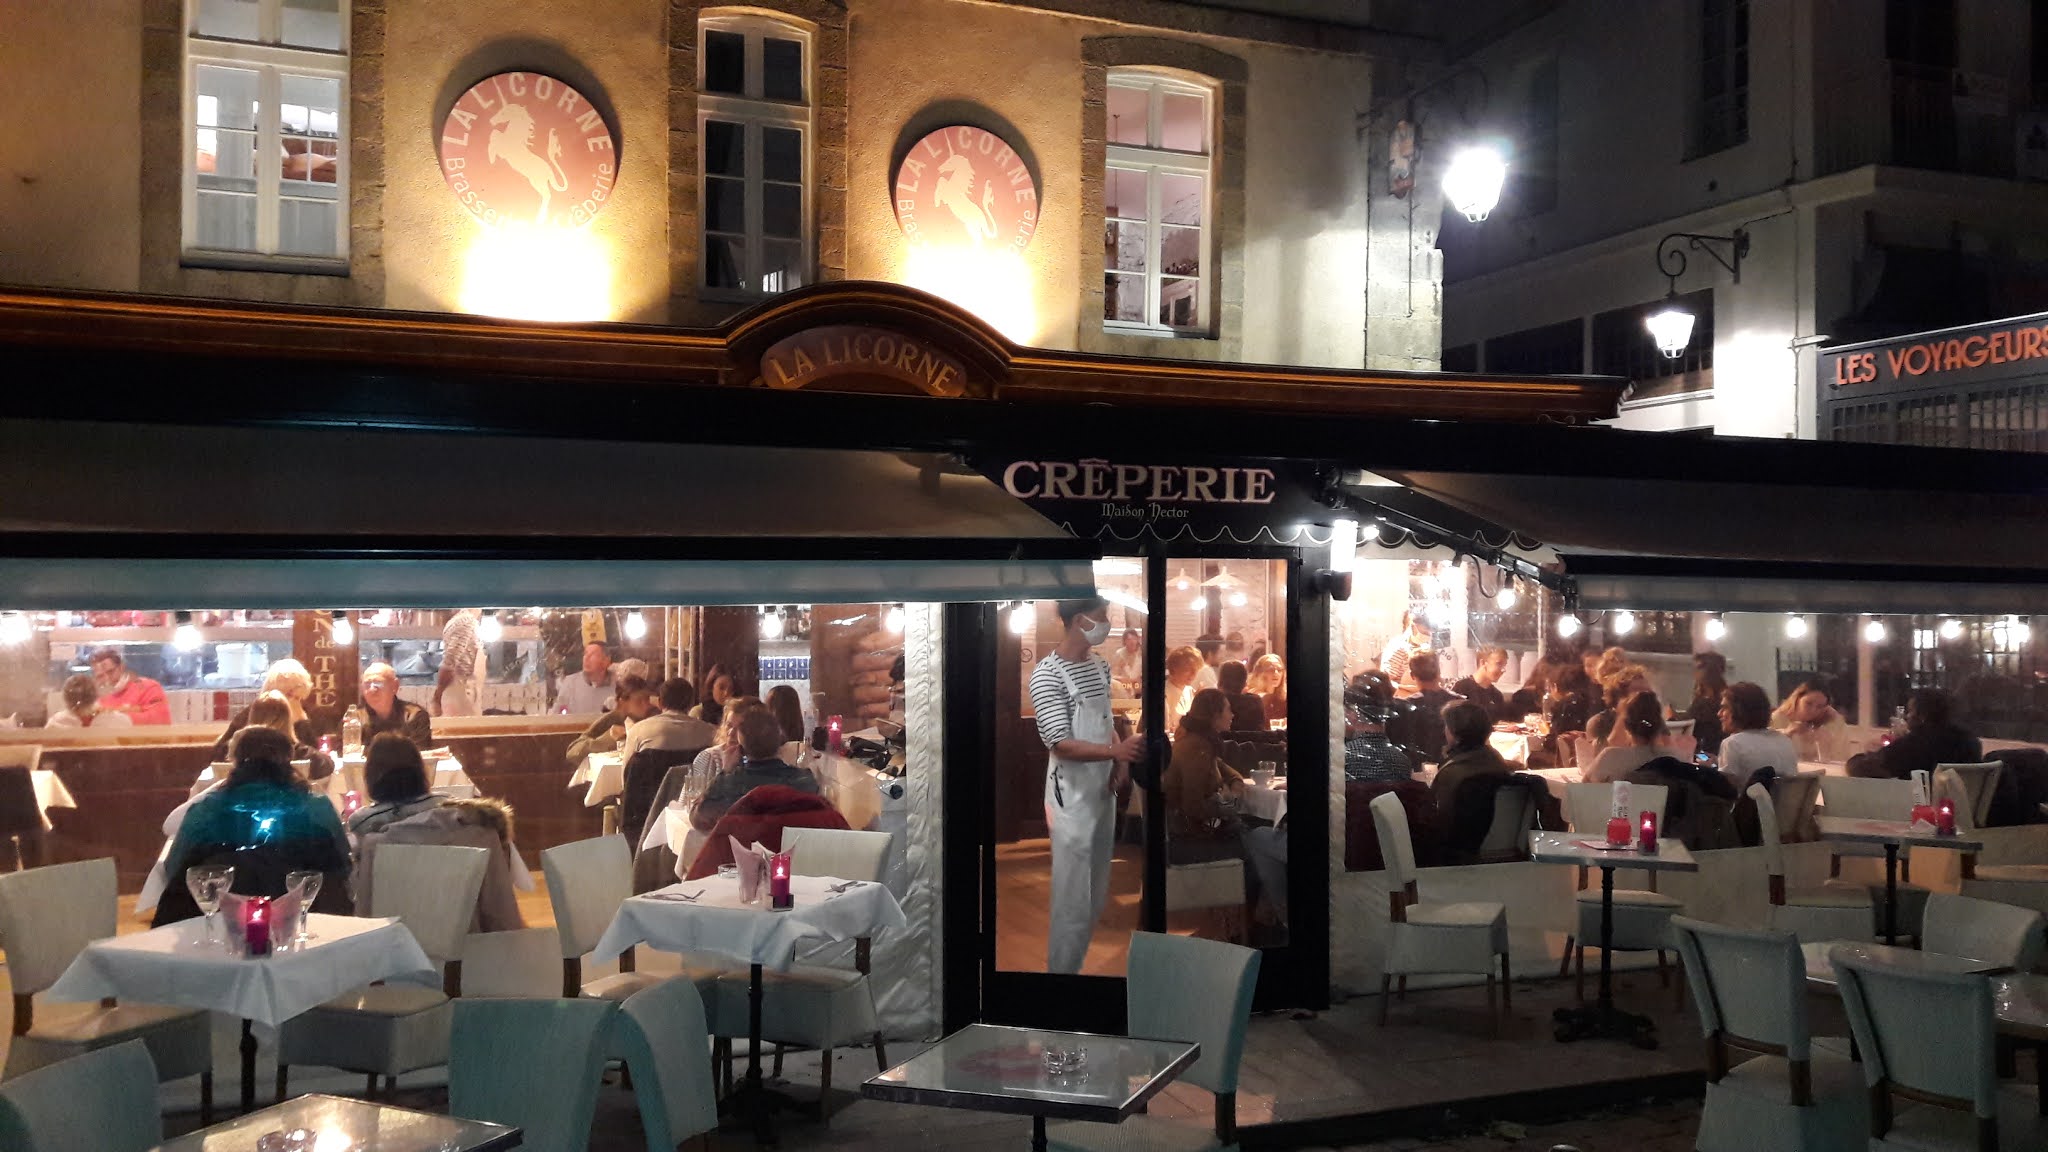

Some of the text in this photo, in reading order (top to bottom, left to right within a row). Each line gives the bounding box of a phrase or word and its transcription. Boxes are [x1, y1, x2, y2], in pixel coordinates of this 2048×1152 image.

[443, 101, 478, 148] LA
[446, 157, 499, 227] Brasse
[897, 157, 927, 193] LA
[769, 334, 958, 394] LA LICORNE
[1835, 352, 1878, 385] LES
[1002, 458, 1277, 504] CRÊPERIE
[1102, 503, 1145, 520] Maison
[314, 635, 336, 649] de
